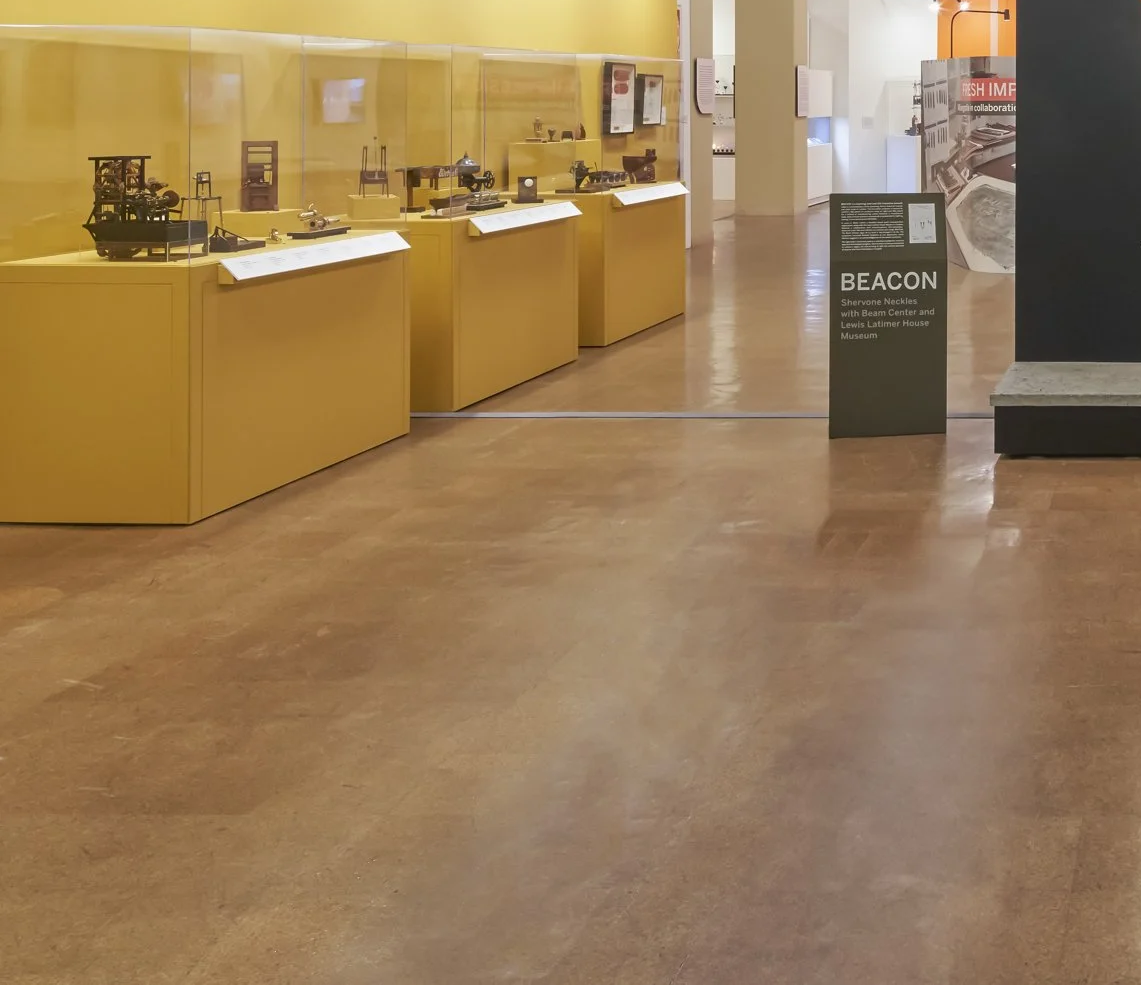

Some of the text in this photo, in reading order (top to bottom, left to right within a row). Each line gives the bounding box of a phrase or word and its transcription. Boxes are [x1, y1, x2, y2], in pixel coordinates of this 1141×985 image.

[841, 270, 937, 291] BEACON
[841, 297, 918, 307] Shervone Neckles
[841, 308, 935, 318] with Beam Center and
[841, 319, 930, 329] Lewis Latimer House
[841, 332, 878, 340] Museum
